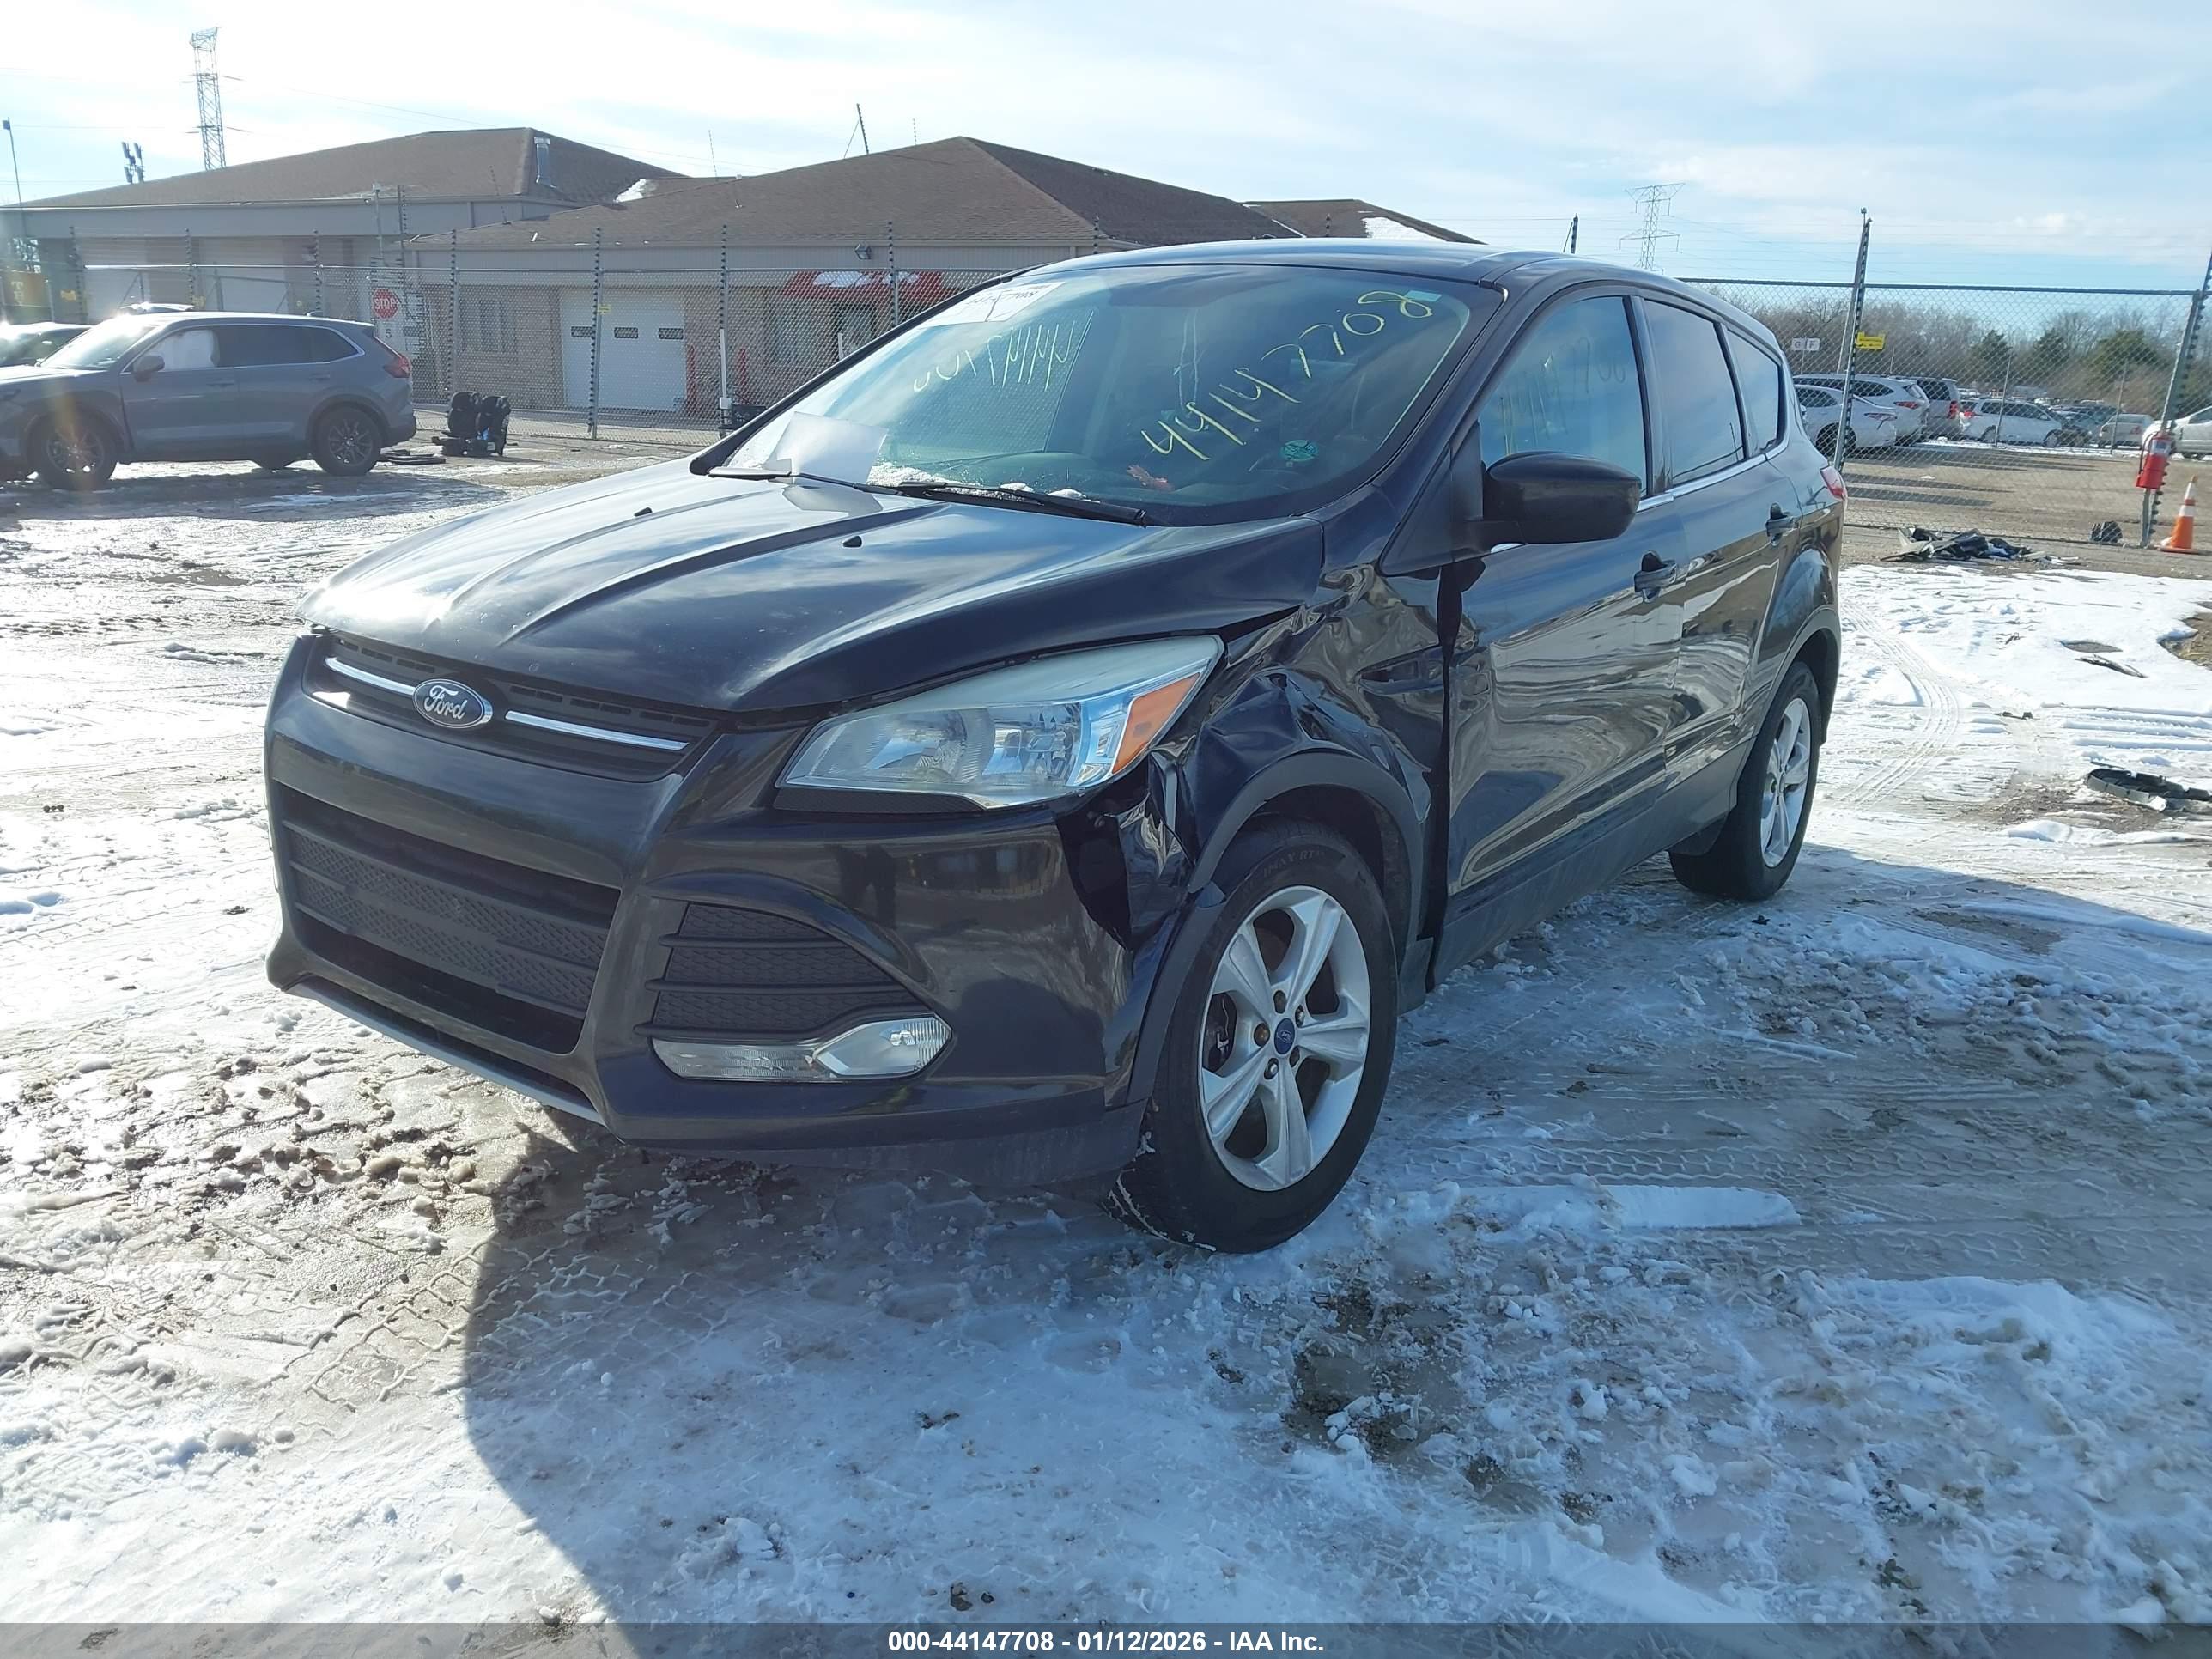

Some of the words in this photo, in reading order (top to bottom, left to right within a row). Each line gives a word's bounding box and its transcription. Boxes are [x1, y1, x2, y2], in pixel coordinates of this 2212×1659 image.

[374, 298, 398, 310] STOP
[1140, 290, 1434, 461] 44147708
[423, 684, 469, 720] Ford
